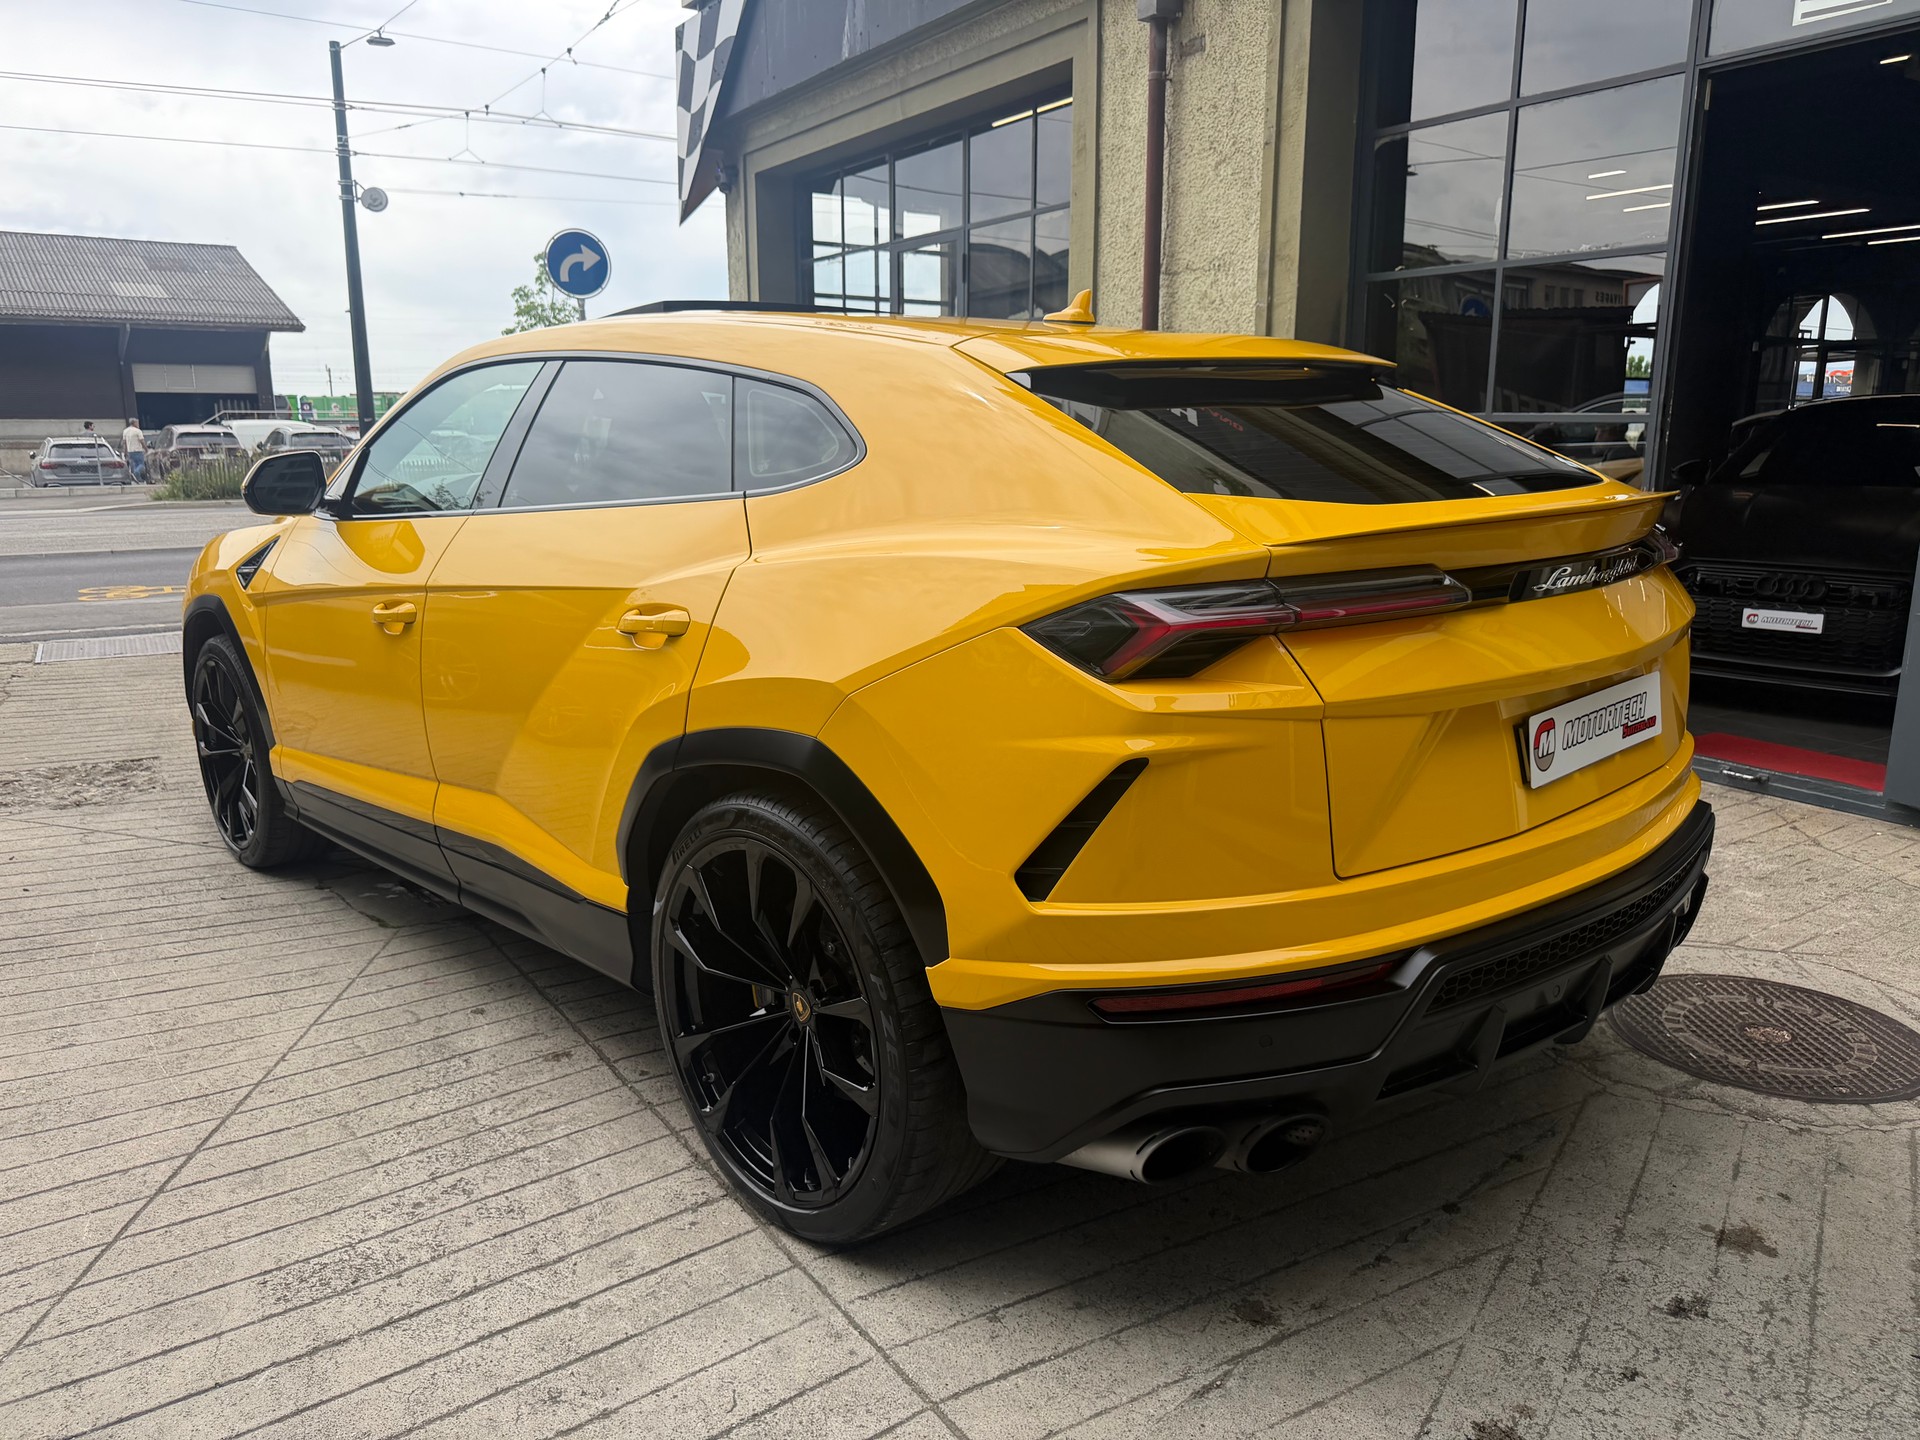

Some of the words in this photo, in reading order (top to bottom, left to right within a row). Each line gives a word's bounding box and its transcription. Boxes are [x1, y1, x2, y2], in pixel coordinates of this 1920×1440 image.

[1532, 555, 1638, 591] Lamborghini
[1562, 691, 1648, 750] MOTORTECH
[672, 824, 703, 865] PIRELLI
[869, 973, 888, 1001] P
